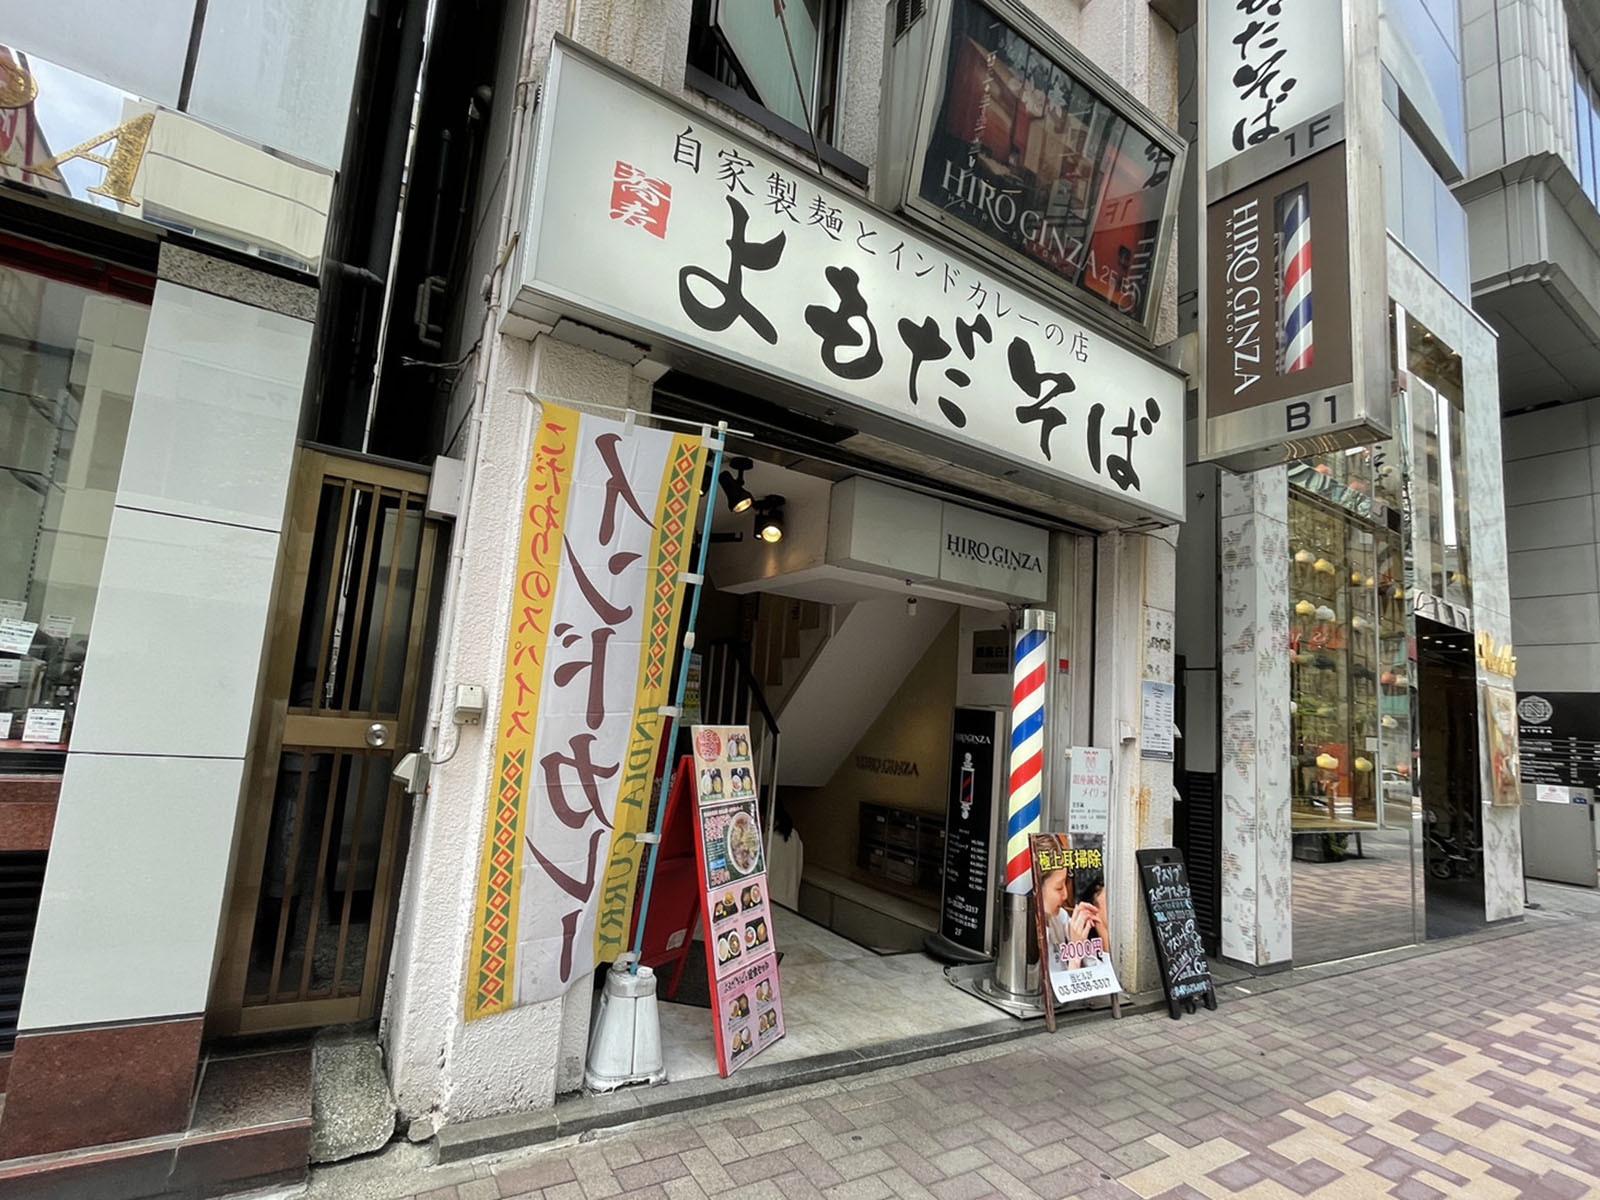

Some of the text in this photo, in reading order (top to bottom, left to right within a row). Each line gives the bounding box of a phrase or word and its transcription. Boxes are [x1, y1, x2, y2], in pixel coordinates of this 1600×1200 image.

[1284, 114, 1331, 157] 1F
[672, 125, 1090, 365] 自家製麺とインドカレーの店
[941, 159, 1017, 233] HIRO
[1019, 209, 1099, 280] GINZA
[1225, 218, 1233, 344] HAIR SALON
[1227, 199, 1261, 395] HIRO GINZA
[678, 195, 1162, 492] よもだそば
[1286, 394, 1338, 432] B1
[947, 533, 990, 563] HIRO
[992, 546, 1043, 573] GINZA
[1038, 848, 1103, 871] 極上耳掃除
[1060, 937, 1104, 961] 2000円
